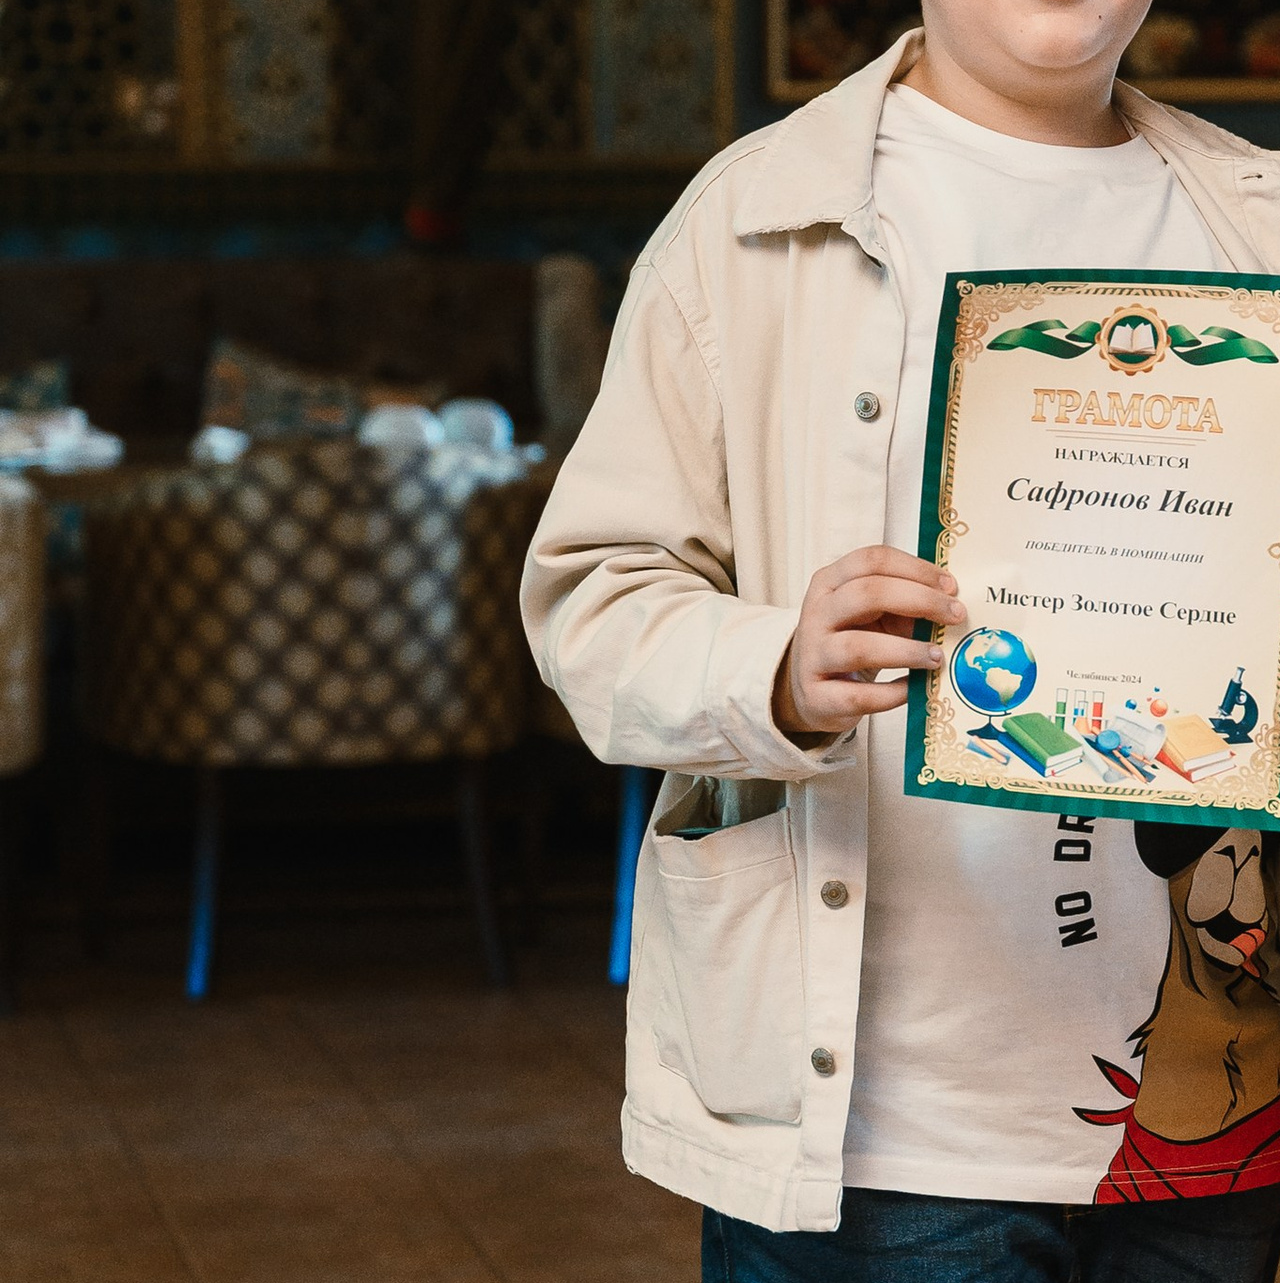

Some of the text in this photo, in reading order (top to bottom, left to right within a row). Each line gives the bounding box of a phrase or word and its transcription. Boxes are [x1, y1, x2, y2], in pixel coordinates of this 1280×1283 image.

[1031, 388, 1223, 433] ГРАМОТА
[1054, 447, 1190, 469] НАГРАЖДАЕТСЯ
[1007, 477, 1234, 517] Сафронов Иван
[1025, 540, 1204, 564] ПОБЕДИТЕЛЬ В НОМИНАЦИИ
[986, 586, 1237, 625] Мистер Золотое Сердце
[1066, 670, 1142, 684] Челябинск 2024
[1055, 890, 1098, 947] NO
